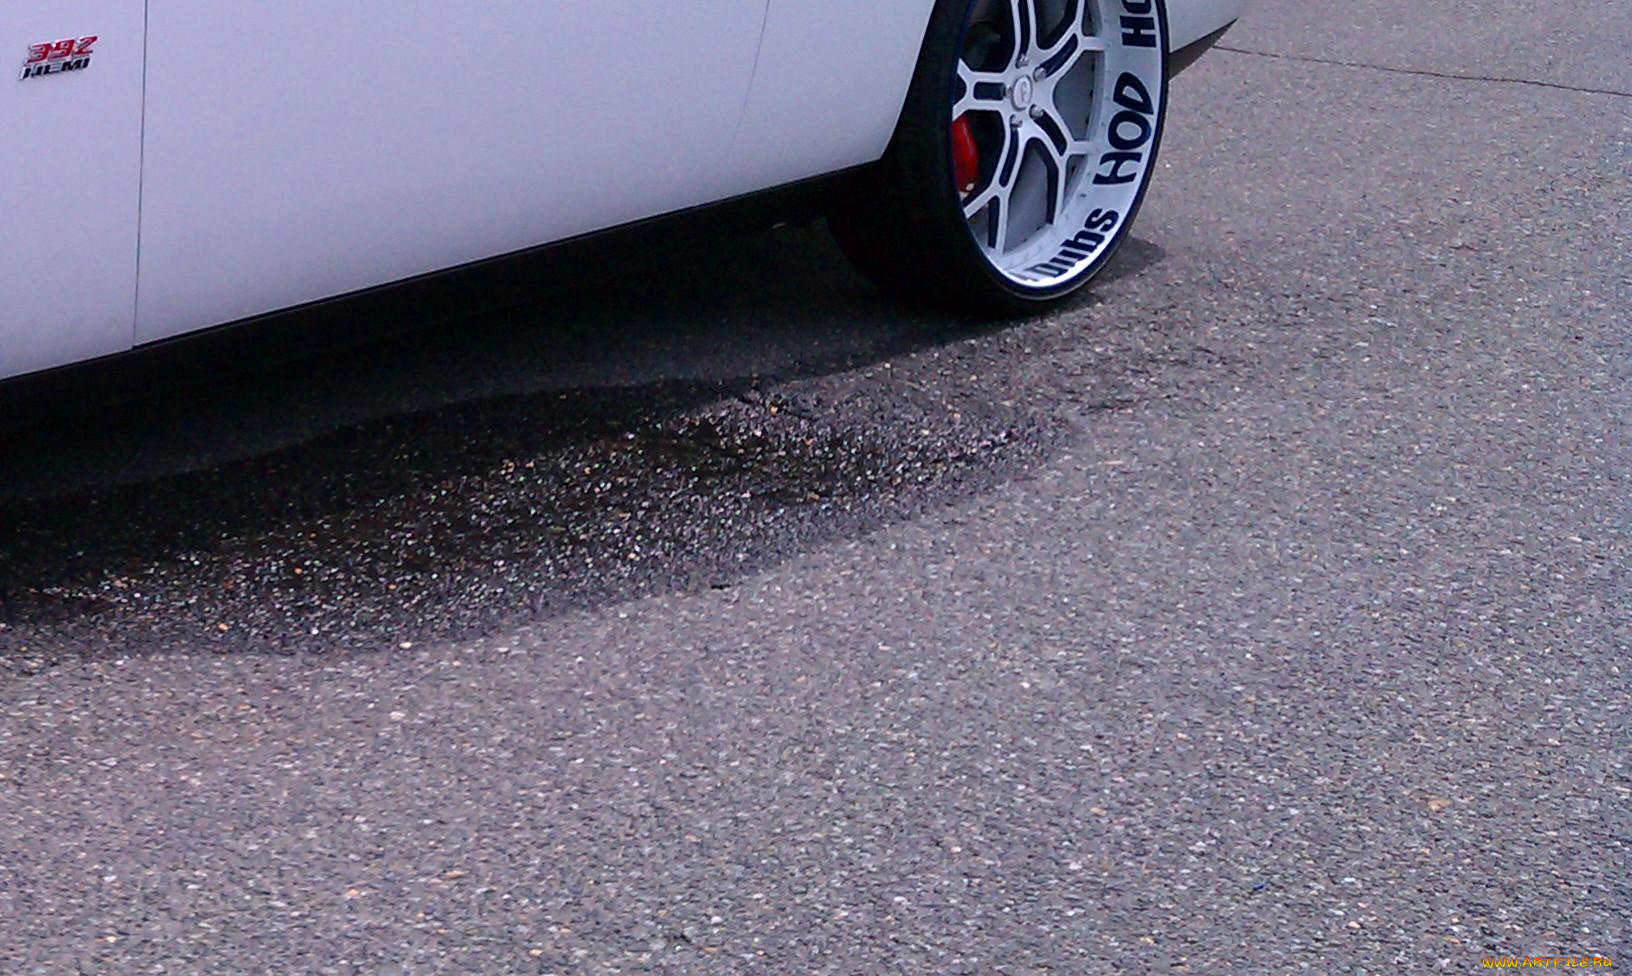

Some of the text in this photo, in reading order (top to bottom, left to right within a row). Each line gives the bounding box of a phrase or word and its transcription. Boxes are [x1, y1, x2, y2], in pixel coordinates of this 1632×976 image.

[25, 34, 99, 64] 392
[19, 57, 92, 80] HEMI
[1093, 71, 1155, 185] HOD
